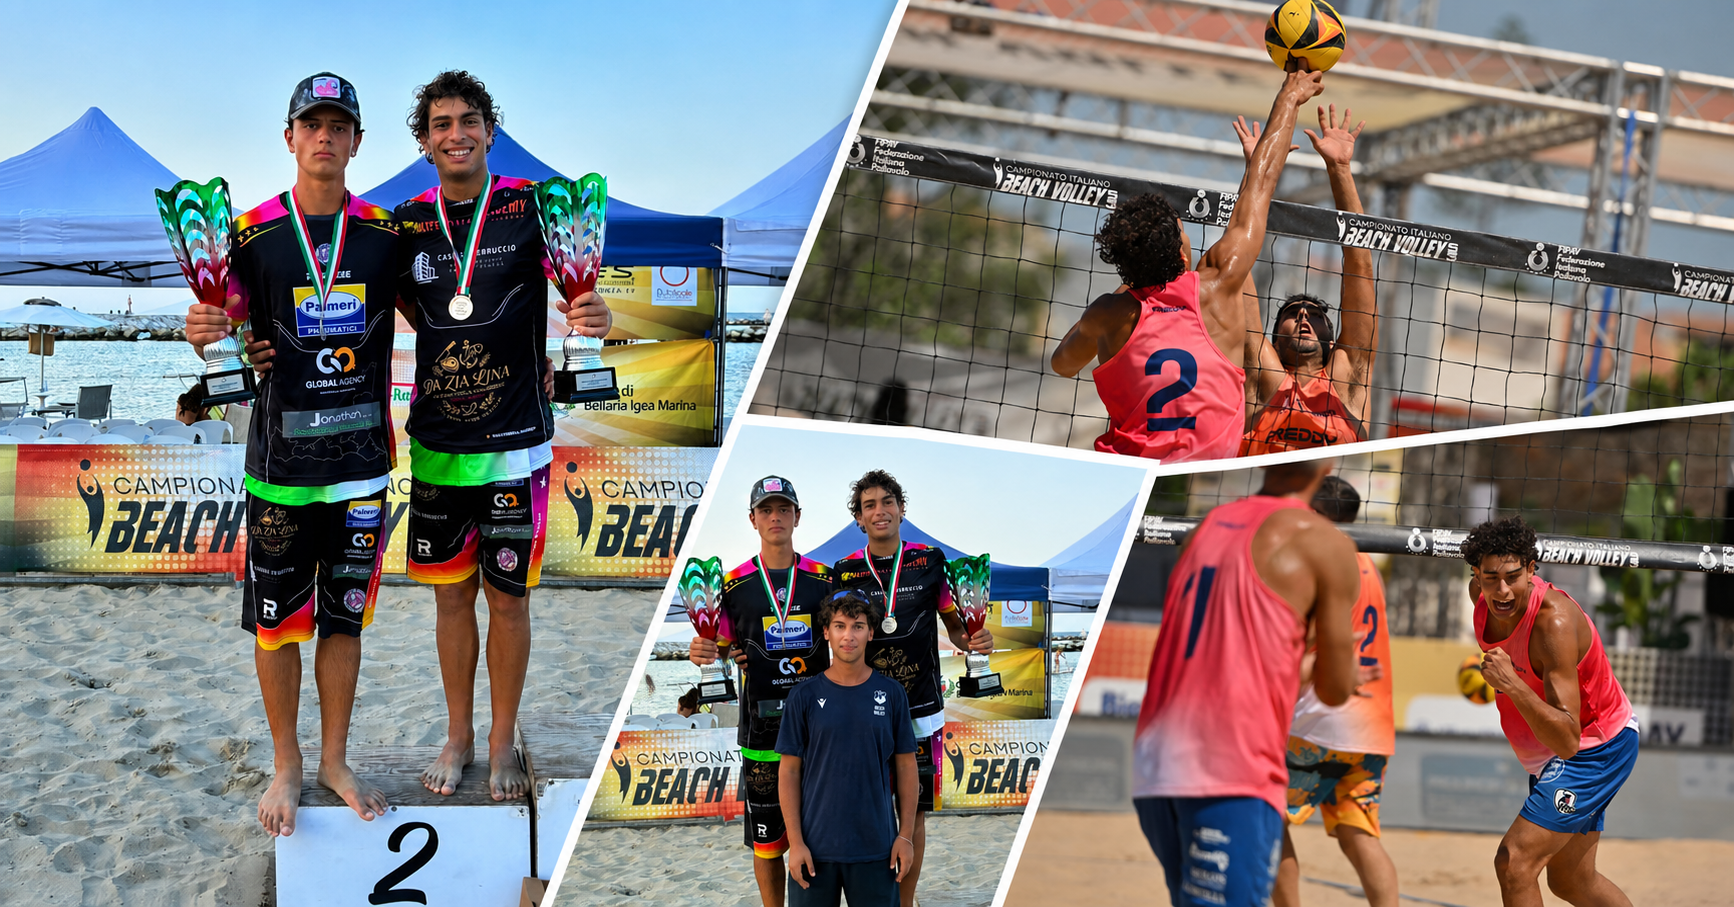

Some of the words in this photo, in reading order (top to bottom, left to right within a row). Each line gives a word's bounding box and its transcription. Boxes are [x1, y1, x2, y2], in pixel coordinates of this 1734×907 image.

[1000, 173, 1051, 198] BEACH
[1051, 181, 1108, 206] VOLLEY
[1006, 165, 1066, 181] CAMPIONATO
[1069, 174, 1111, 188] ITALIANO
[1343, 227, 1394, 251] BEACH
[1393, 234, 1449, 259] VOLLEY
[1349, 218, 1408, 235] CAMPIONATO
[1411, 228, 1452, 241] ITALIANO
[1680, 278, 1728, 302] BEACH
[305, 379, 338, 389] GLOBAL
[339, 374, 366, 386] AGENCY
[423, 379, 441, 395] DA
[444, 374, 470, 392] ZIA
[472, 365, 510, 386] LINA
[621, 384, 634, 397] di
[1145, 348, 1198, 432] 2
[584, 400, 628, 411] Bellaria
[631, 400, 655, 414] Igea
[658, 400, 697, 411] Marina
[104, 500, 246, 554] BEACH
[1542, 546, 1584, 565] BEACH
[1584, 549, 1630, 568] VOLLEY
[1182, 565, 1217, 659] 1
[1359, 604, 1378, 666] 2
[632, 766, 731, 806] BEACH
[368, 821, 439, 905] 2
